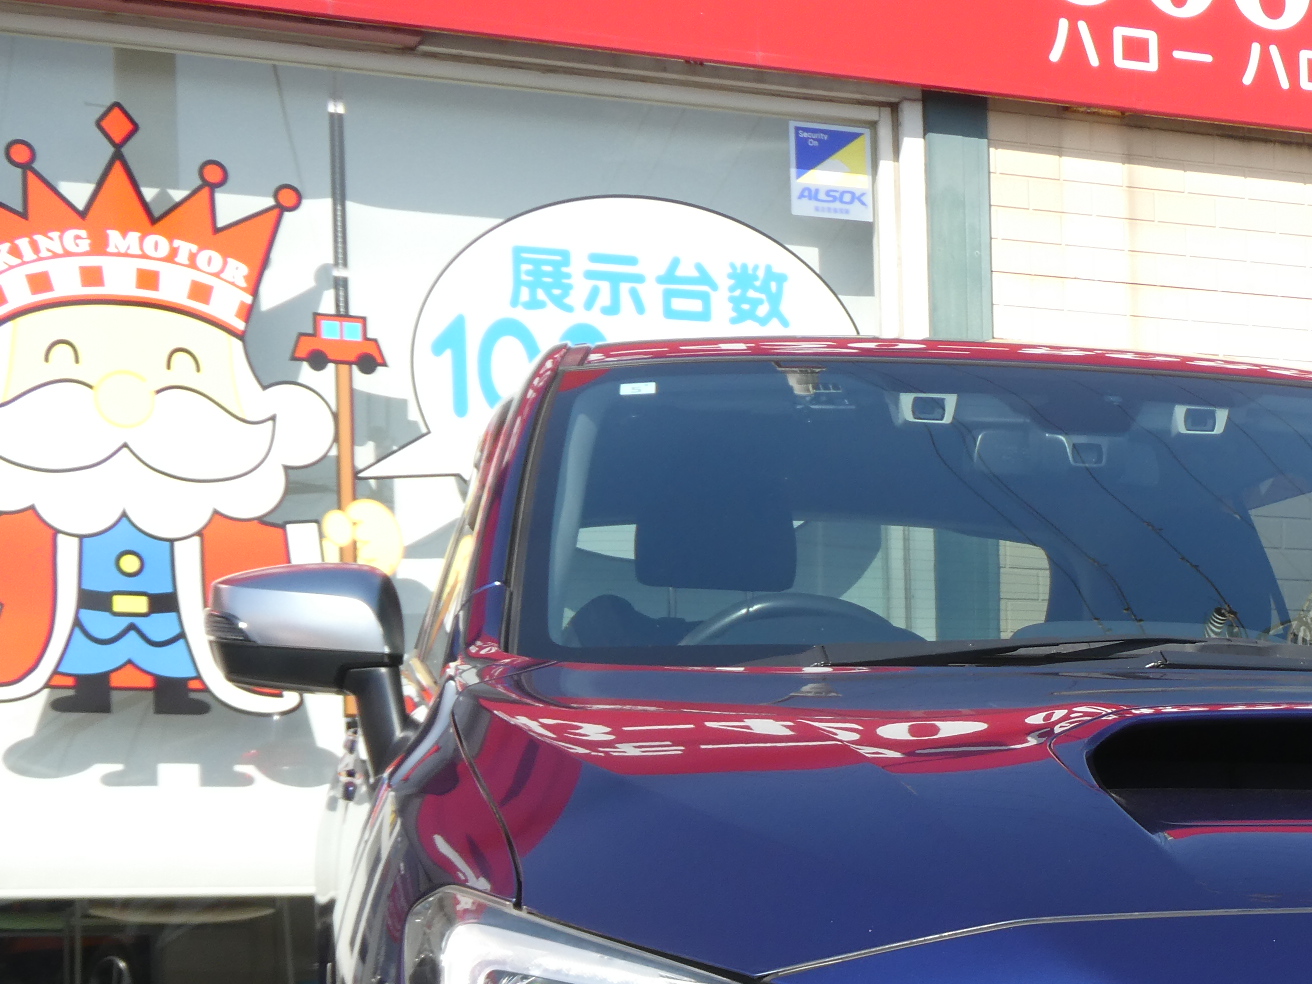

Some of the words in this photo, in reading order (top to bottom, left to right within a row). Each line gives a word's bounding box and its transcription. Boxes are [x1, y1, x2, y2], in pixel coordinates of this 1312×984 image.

[1048, 18, 1213, 72] ハロー
[798, 130, 828, 140] Security
[808, 139, 819, 147] On
[797, 186, 869, 207] ALSOK
[0, 229, 91, 270] KING
[106, 229, 250, 288] MOTOR
[510, 245, 790, 329] 展示台数
